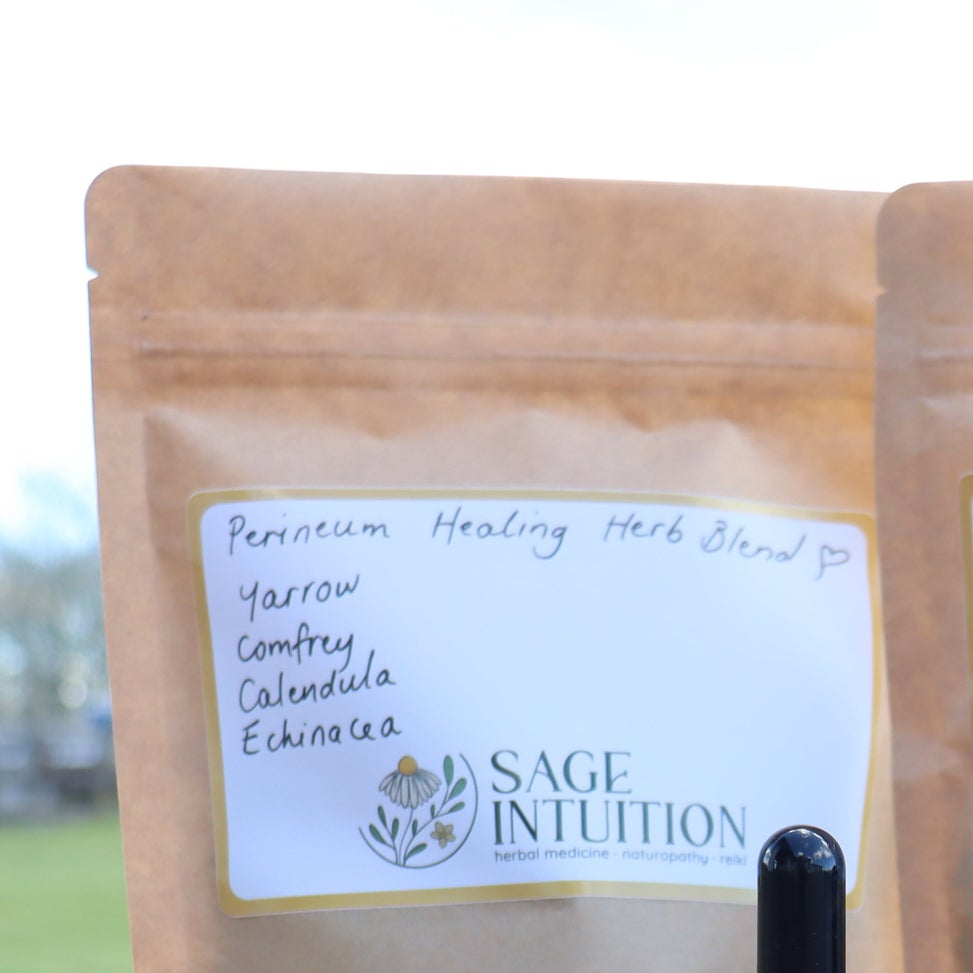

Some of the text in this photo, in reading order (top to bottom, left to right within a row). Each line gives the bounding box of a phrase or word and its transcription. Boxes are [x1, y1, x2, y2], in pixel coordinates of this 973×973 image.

[228, 507, 804, 563] Perineum Healing Herb Blend
[238, 650, 396, 714] Calendula
[242, 715, 402, 755] Echinacea
[490, 749, 632, 794] SAGE
[493, 800, 747, 849] INTUITION
[495, 846, 747, 866] herbal medicine naturopathy reiki
